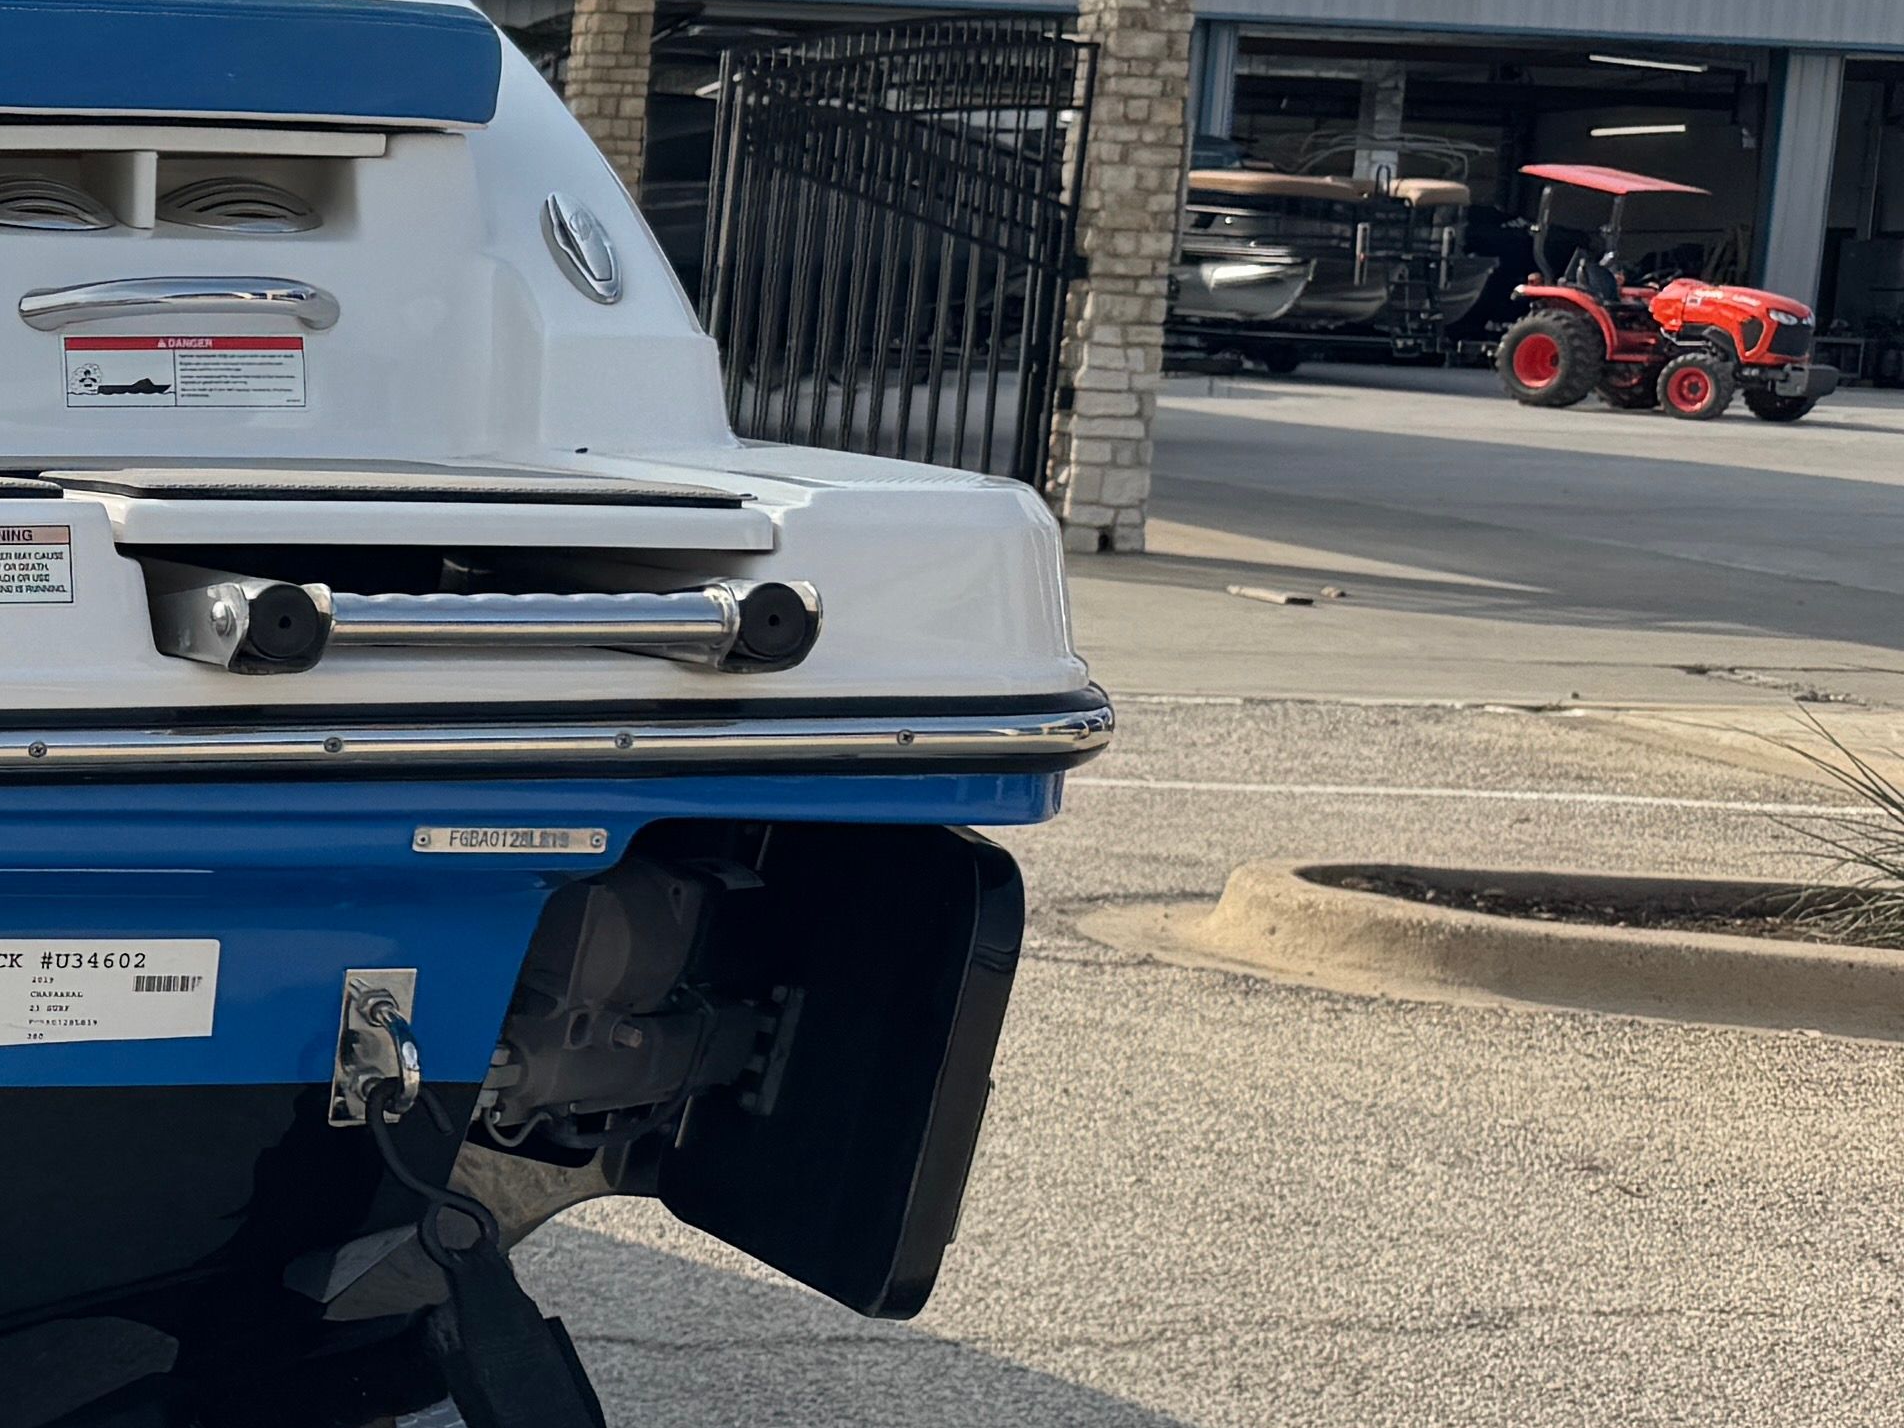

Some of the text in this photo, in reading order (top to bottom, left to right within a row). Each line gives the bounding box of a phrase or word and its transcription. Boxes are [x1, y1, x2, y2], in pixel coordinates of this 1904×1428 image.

[168, 338, 213, 348] DANGER
[34, 551, 64, 560] CAUSE
[4, 563, 16, 571] OR
[17, 574, 30, 582] OR
[32, 573, 50, 582] USE
[40, 951, 147, 970] #U34602
[31, 976, 55, 984] 2019
